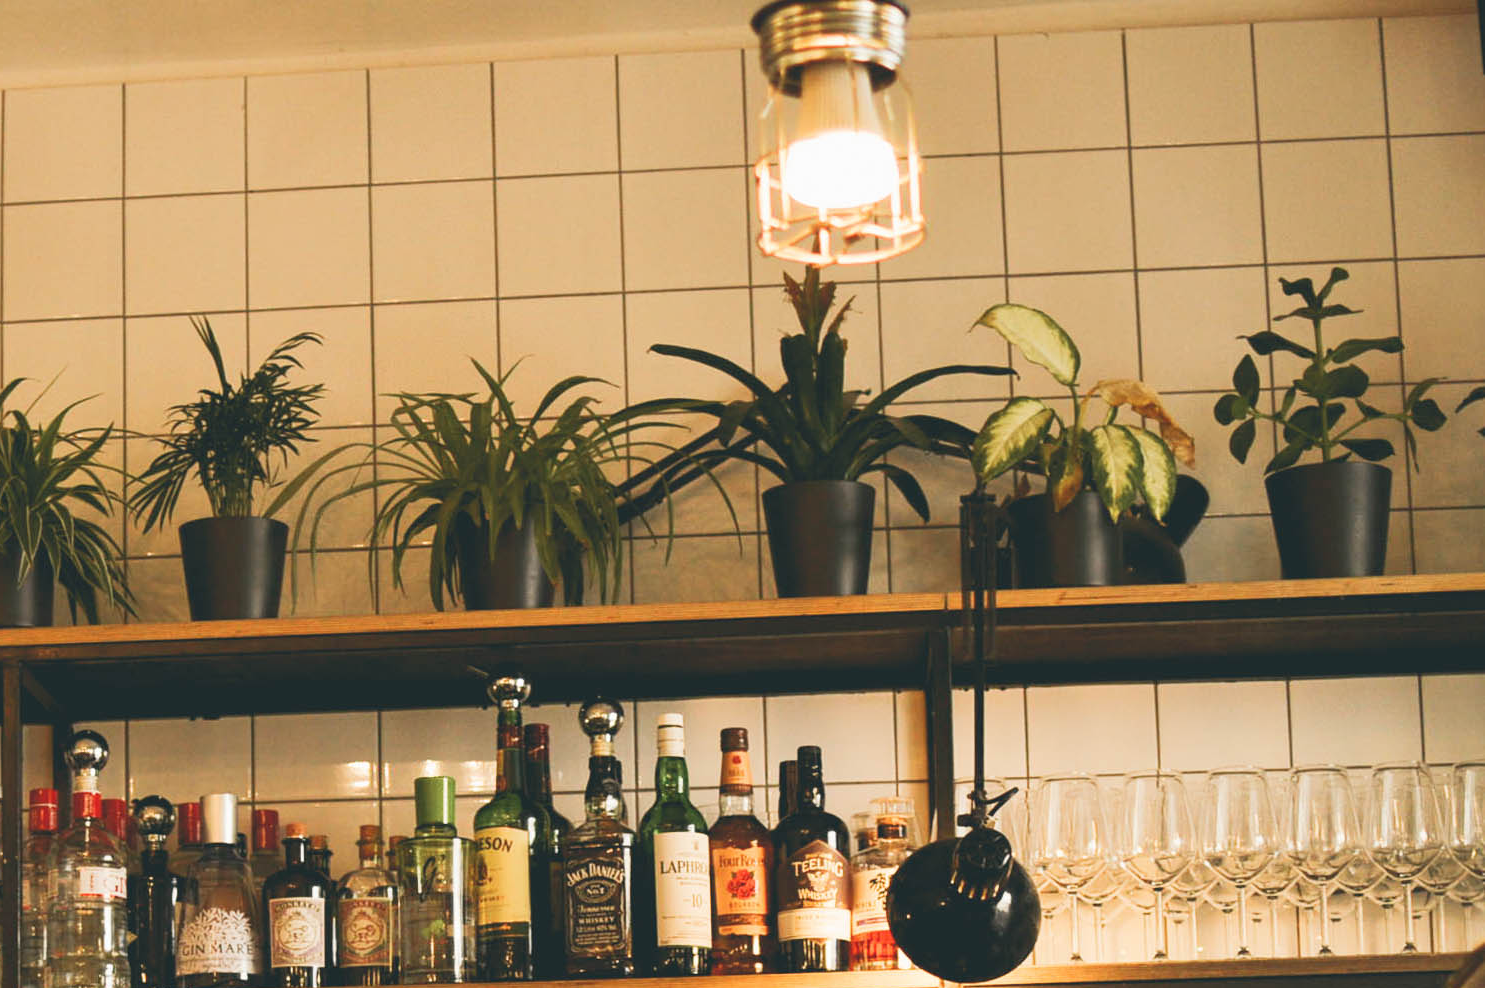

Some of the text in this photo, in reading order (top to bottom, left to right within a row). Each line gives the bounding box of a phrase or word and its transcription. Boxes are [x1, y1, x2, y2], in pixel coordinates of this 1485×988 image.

[477, 836, 513, 853] ESON
[792, 857, 843, 877] TEELING
[566, 868, 589, 887] JACK
[798, 887, 838, 900] WHISKEY
[182, 943, 253, 957] GIN MARE
